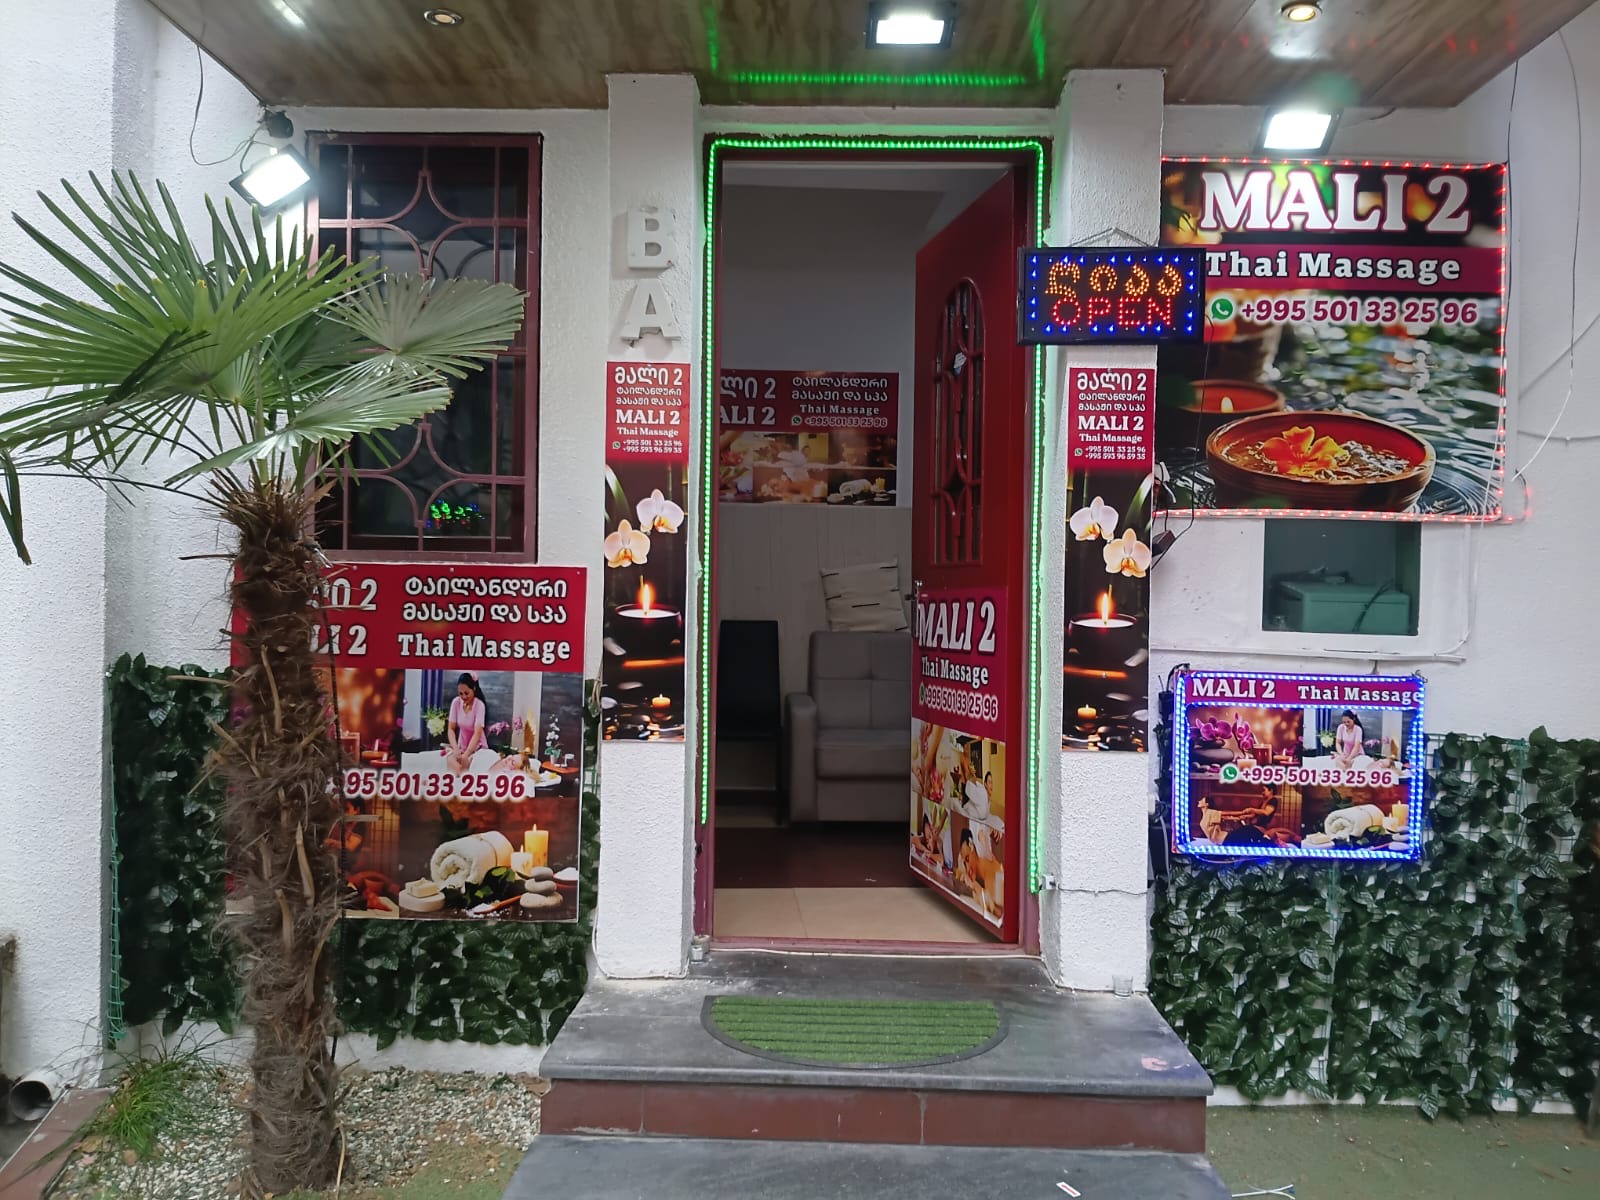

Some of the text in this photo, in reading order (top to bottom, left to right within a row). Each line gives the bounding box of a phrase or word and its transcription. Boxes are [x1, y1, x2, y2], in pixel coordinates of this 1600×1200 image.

[1200, 170, 1470, 233] MALI 2
[1205, 251, 1461, 284] Thai Massage
[1045, 261, 1184, 299] ღიაა
[1052, 297, 1172, 326] OPEN
[1241, 299, 1477, 324] +995 501 33 25 96
[614, 366, 683, 386] მალი 2
[792, 377, 888, 389] ტაილანდური
[1077, 372, 1147, 391] მალი 2
[764, 377, 776, 400] 2
[791, 390, 888, 402] მასაჟი და სპა
[651, 397, 664, 406] და
[799, 404, 880, 417] Thai Massage
[1114, 403, 1127, 411] და
[615, 409, 681, 425] MALI 2
[761, 406, 776, 425] 2
[805, 417, 888, 428] +995 501 33 25 96
[1078, 415, 1144, 431] MALI 2
[617, 426, 679, 438] Thai Massage
[1079, 433, 1143, 444] Thai Massage
[360, 577, 378, 610] 2
[404, 576, 568, 599] ტაილანდური
[402, 601, 568, 624] მასაჟი და სპა
[916, 600, 996, 653] MALI 2
[348, 624, 367, 655] 2
[398, 632, 571, 664] Thai Massage
[921, 655, 989, 689] Thai Massage
[1191, 677, 1421, 706] MALI 2 Thai Massage
[942, 689, 956, 710] 501
[957, 692, 967, 713] 33
[968, 694, 981, 716] 25
[983, 696, 997, 719] 96
[381, 772, 420, 796] 501
[426, 773, 455, 797] 33
[460, 774, 489, 797] 25
[495, 775, 525, 798] 96
[1242, 767, 1392, 785] +995 501 33 25 96
